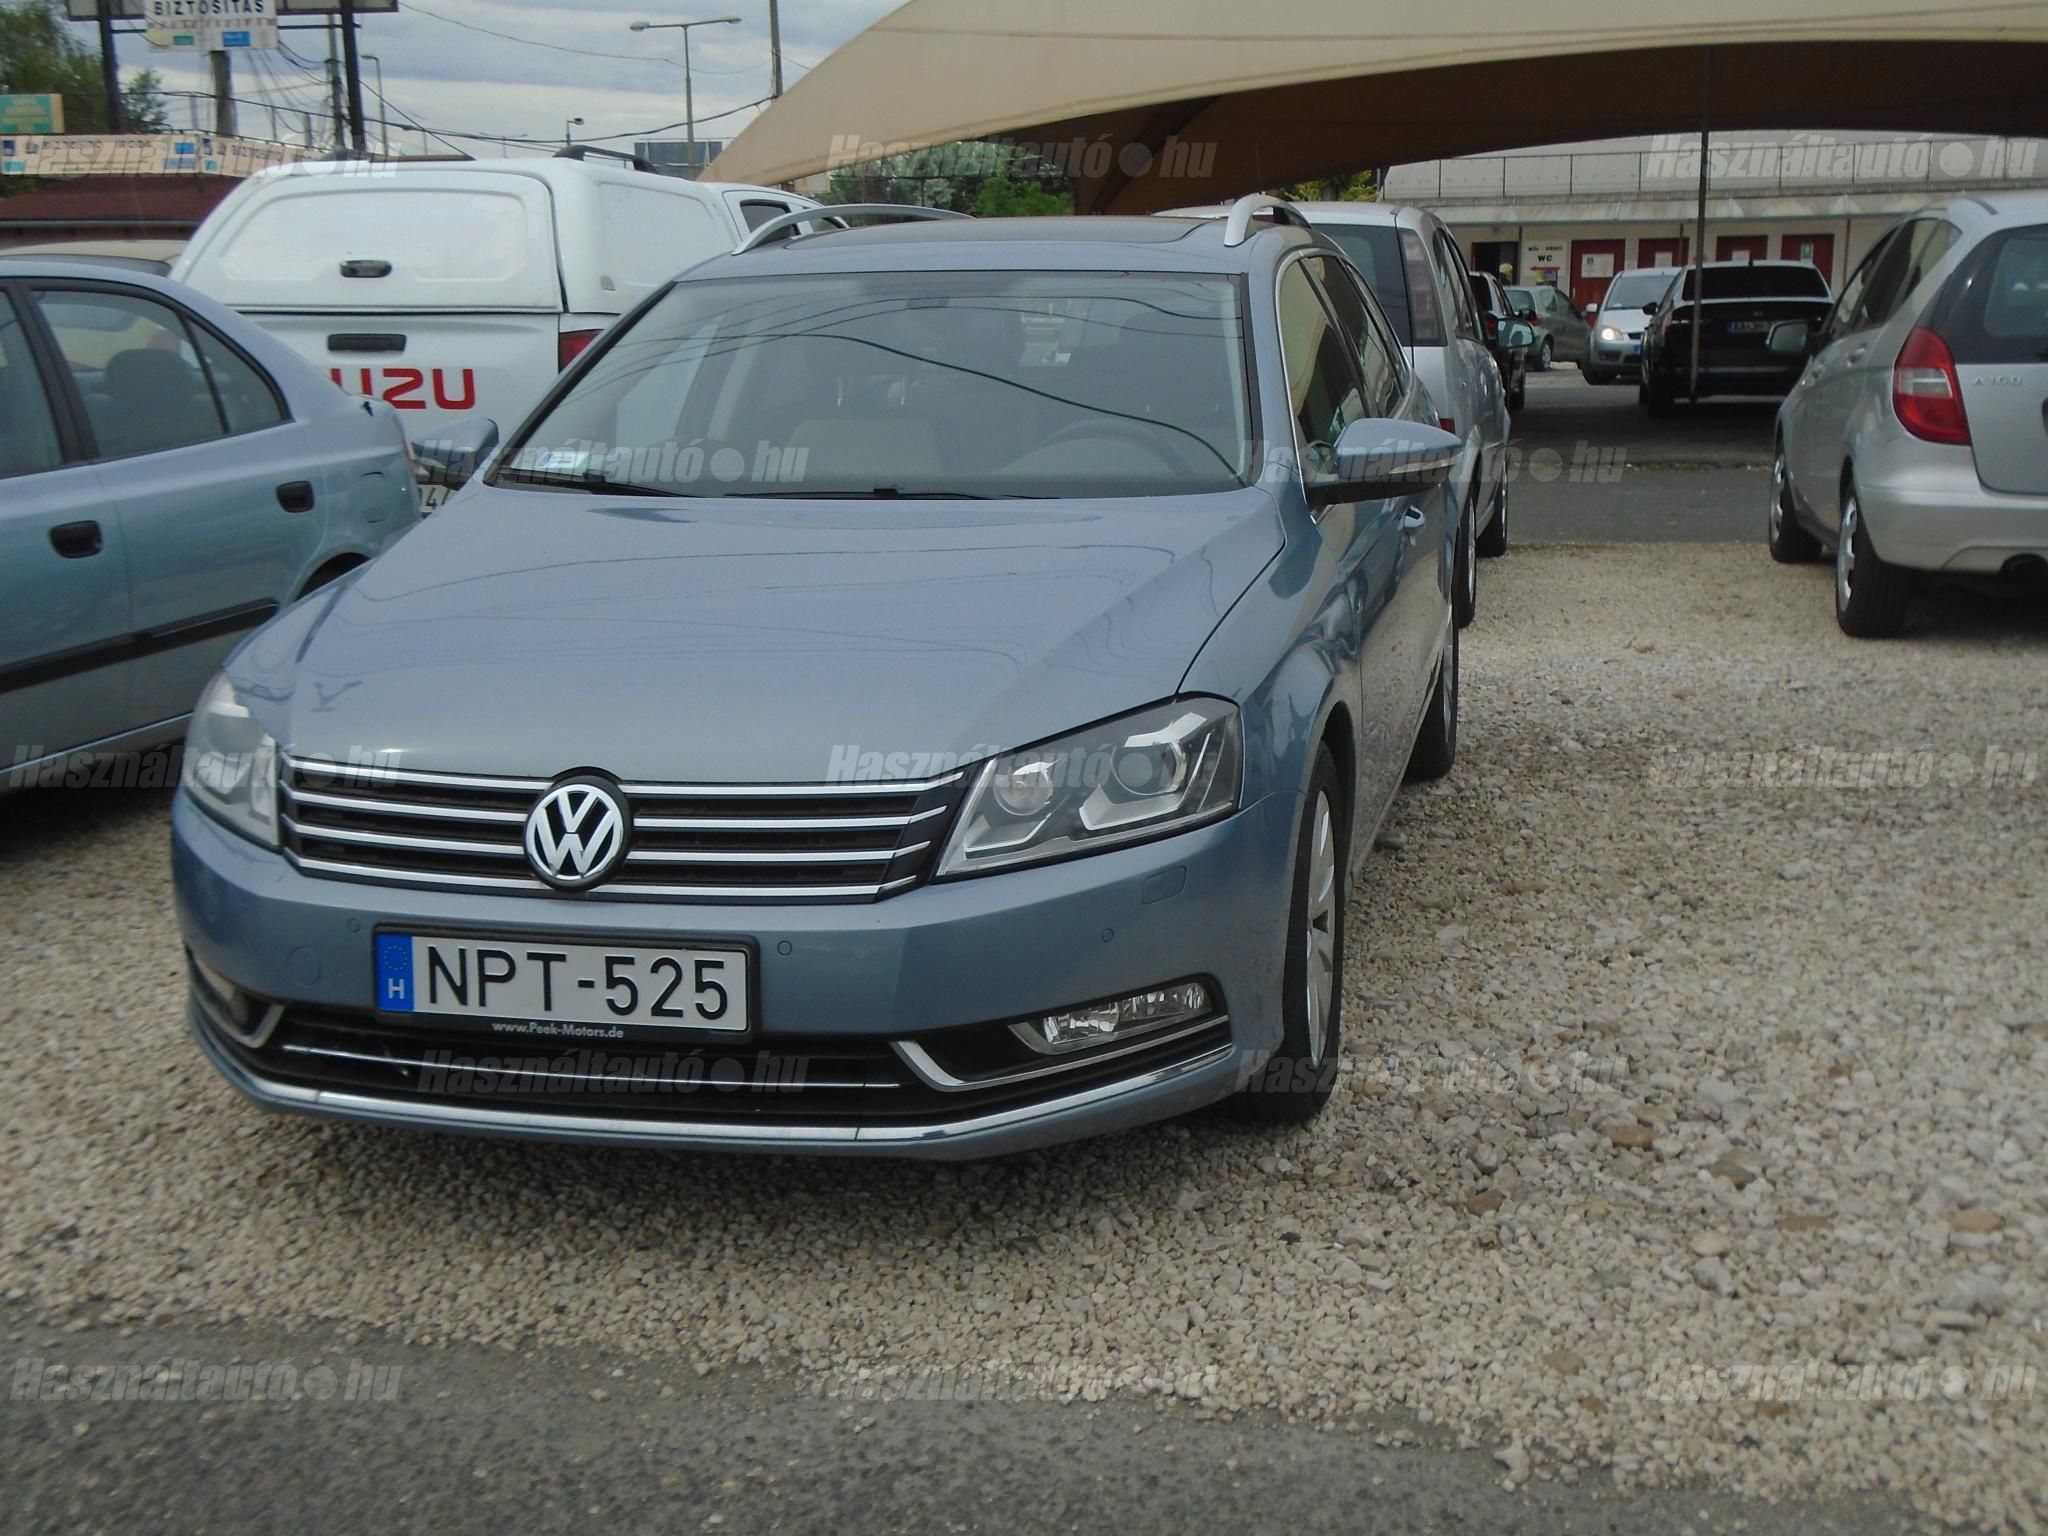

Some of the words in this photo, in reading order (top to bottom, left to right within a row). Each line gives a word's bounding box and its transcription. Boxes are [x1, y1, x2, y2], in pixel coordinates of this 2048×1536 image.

[387, 977, 406, 1000] H
[426, 945, 729, 1021] NPT-525
[491, 1021, 624, 1039] www.Peek-Motors.de
